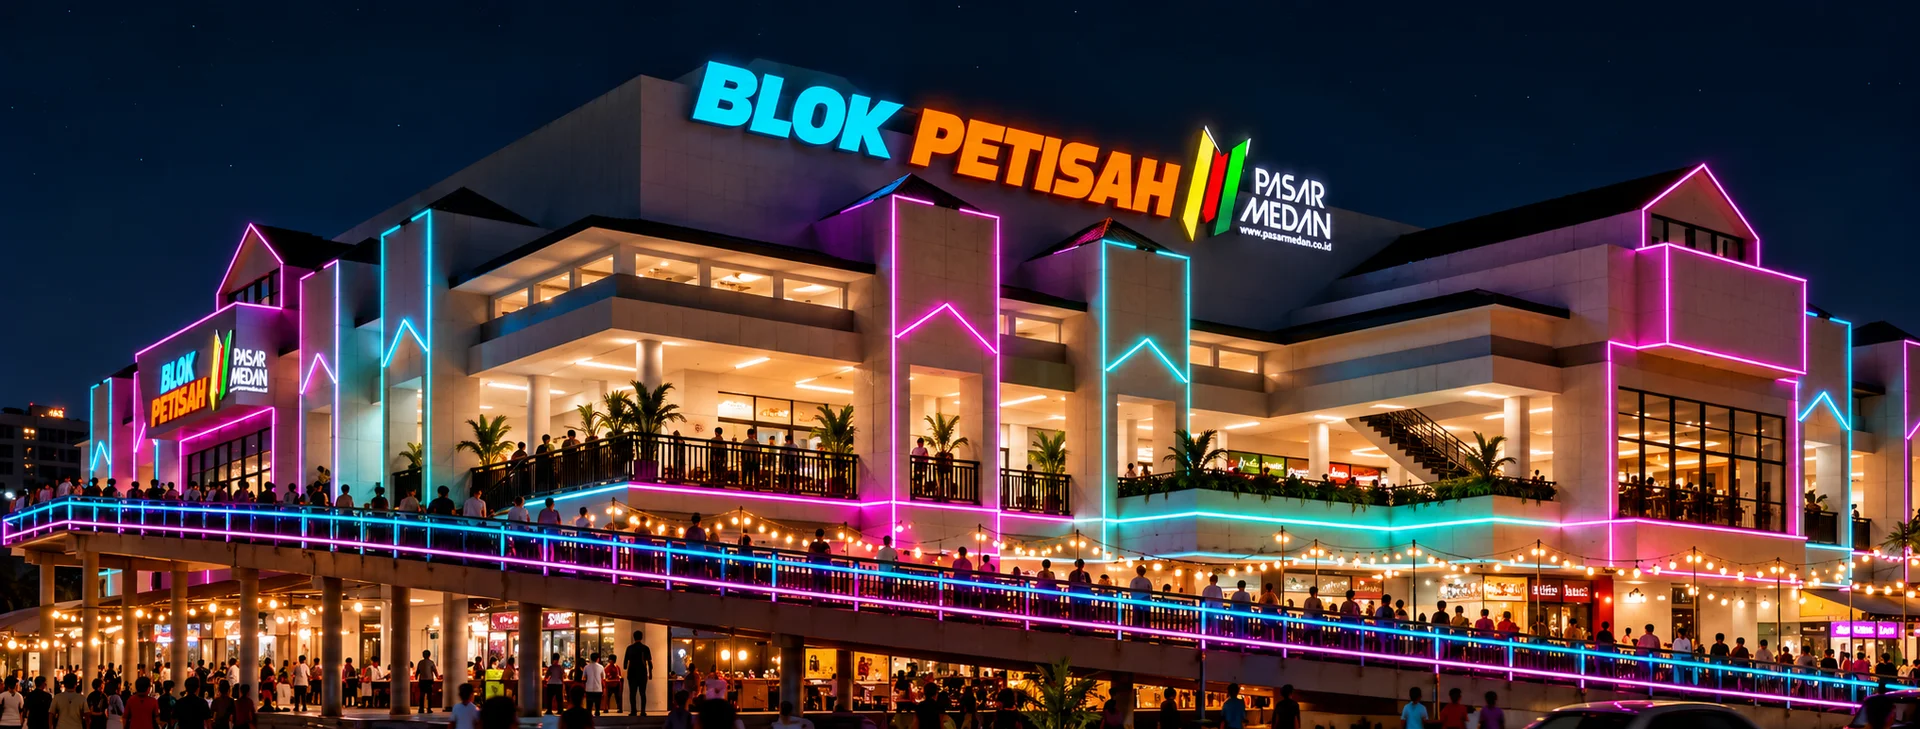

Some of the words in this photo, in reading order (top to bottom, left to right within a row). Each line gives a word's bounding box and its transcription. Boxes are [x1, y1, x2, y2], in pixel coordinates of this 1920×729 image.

[691, 61, 904, 159] BLOK
[911, 108, 1181, 217] PETISAH
[1255, 167, 1325, 209] PASAR
[1240, 196, 1331, 240] MEDAN
[1240, 226, 1332, 252] www.pasarmedan.co.id
[160, 350, 197, 395] BLOK
[229, 367, 268, 387] MEDAN
[233, 347, 266, 368] PASAR
[151, 376, 208, 428] PETISAH
